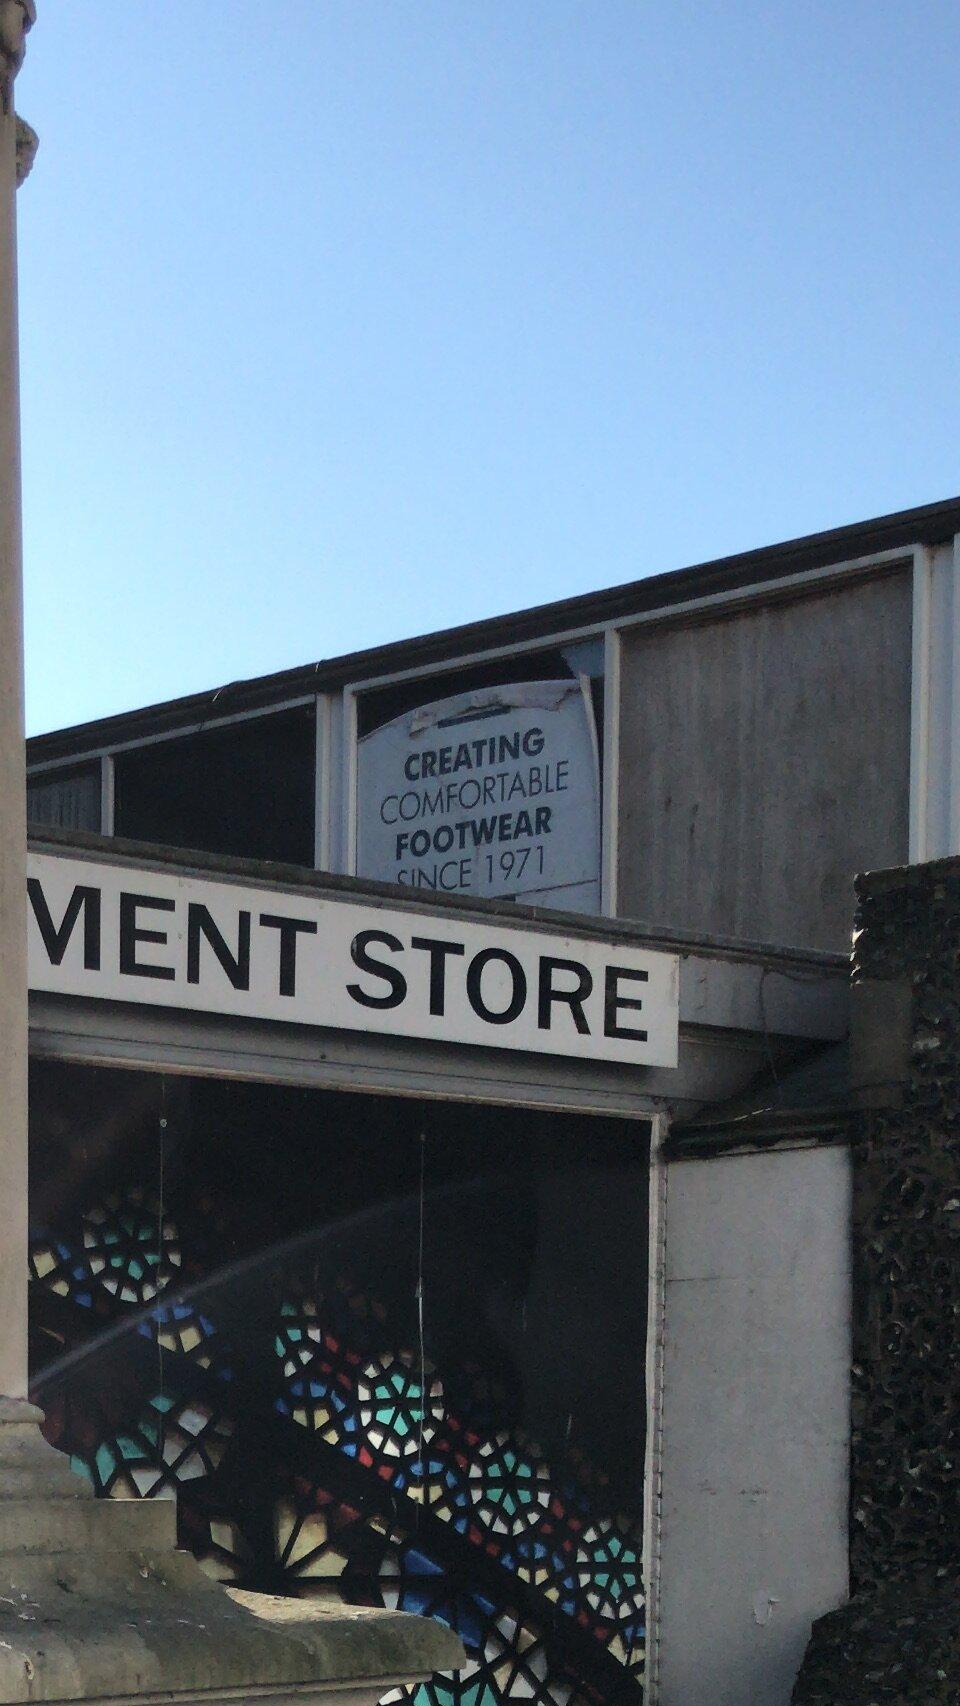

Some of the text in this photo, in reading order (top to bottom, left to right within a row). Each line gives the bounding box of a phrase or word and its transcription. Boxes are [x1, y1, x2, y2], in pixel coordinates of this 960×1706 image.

[404, 727, 545, 781] CREATING
[380, 760, 569, 825] COMFORTABLE
[395, 806, 552, 861] FOOTWEAR
[397, 845, 544, 891] SINCE 1971
[345, 929, 650, 1042] STORE
